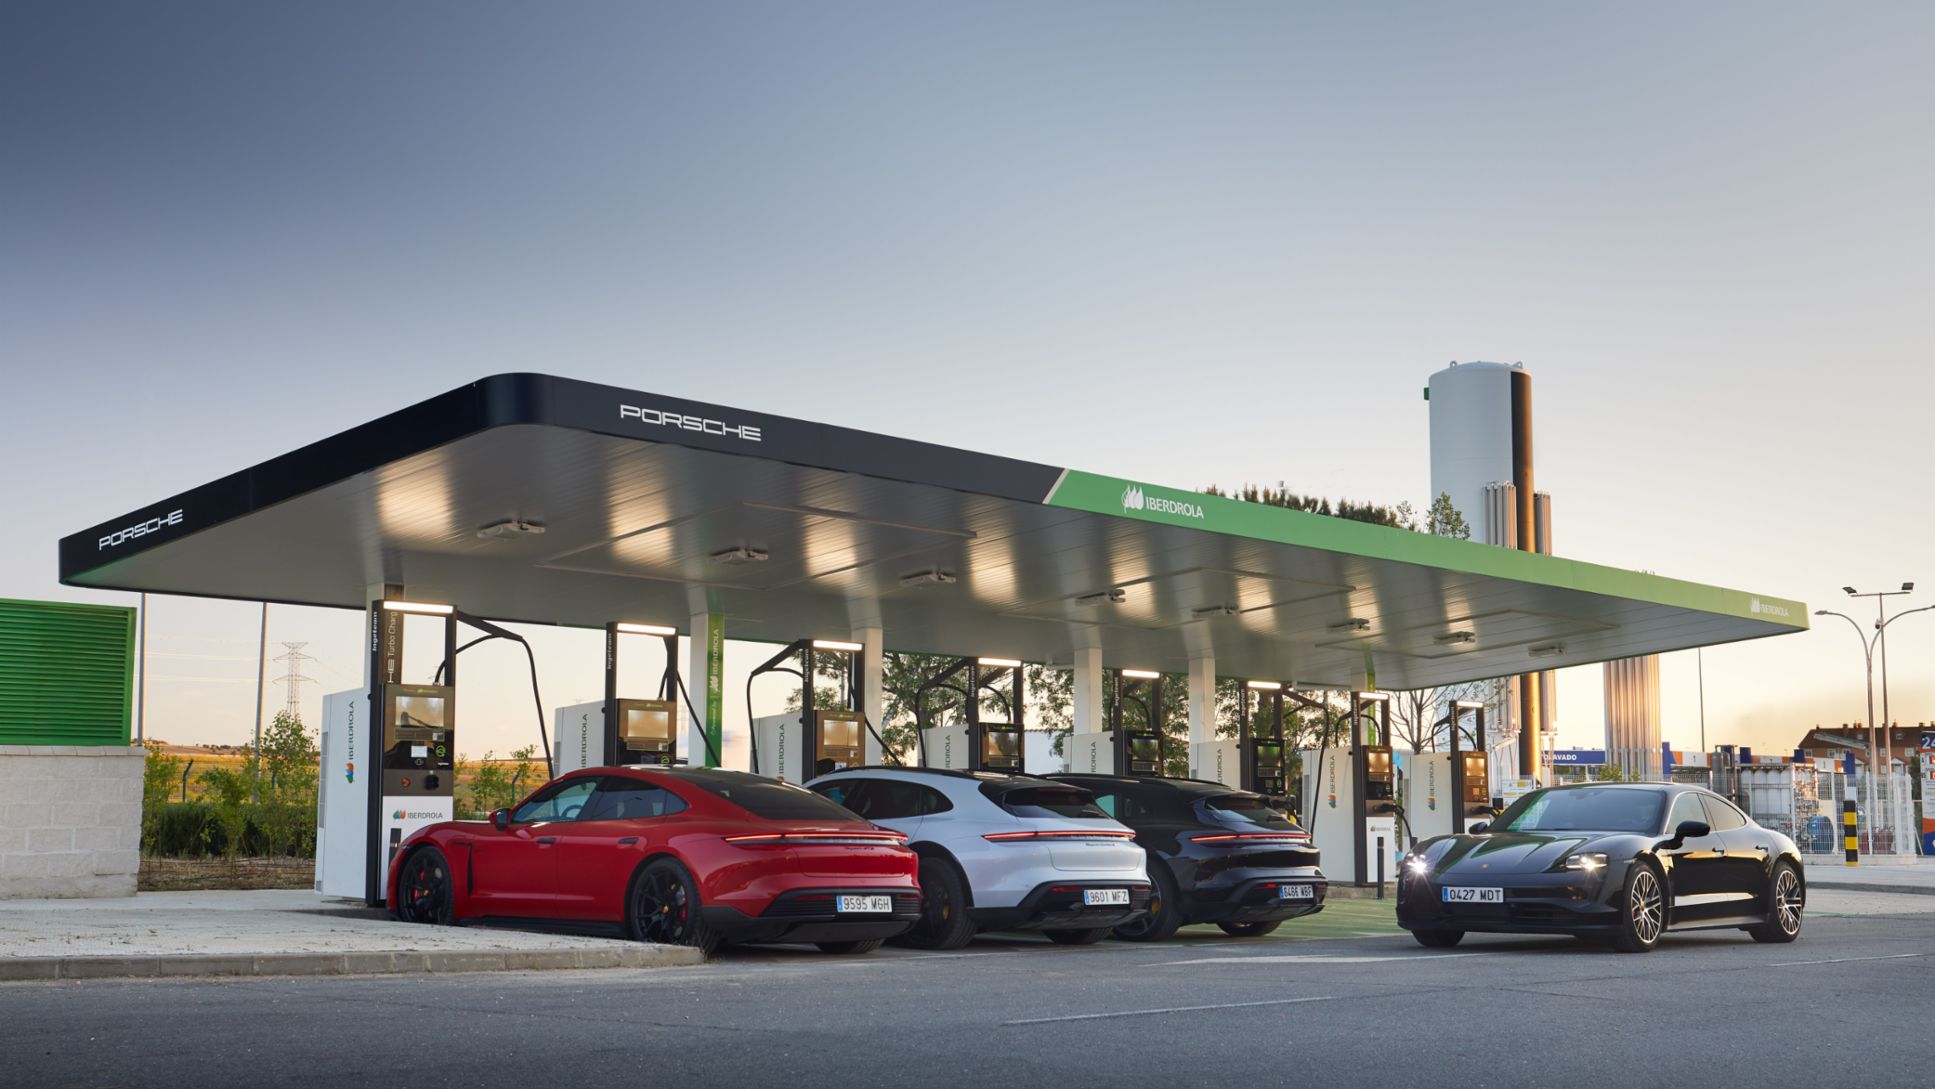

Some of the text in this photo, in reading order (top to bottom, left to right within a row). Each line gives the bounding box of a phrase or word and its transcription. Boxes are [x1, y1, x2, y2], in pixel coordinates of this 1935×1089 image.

[619, 404, 762, 442] PORSCHE
[1145, 496, 1204, 519] IBERDROLA
[98, 508, 183, 551] PORSCHE
[387, 611, 398, 634] Charg
[387, 635, 396, 657] Turbo
[712, 629, 720, 675] IBERDROLA
[407, 812, 443, 820] IBERDROLA
[843, 898, 890, 910] 9595 MGH
[1089, 891, 1128, 903] 9601 MFZ
[1449, 889, 1475, 901] 0427
[1480, 889, 1501, 901] MDT
